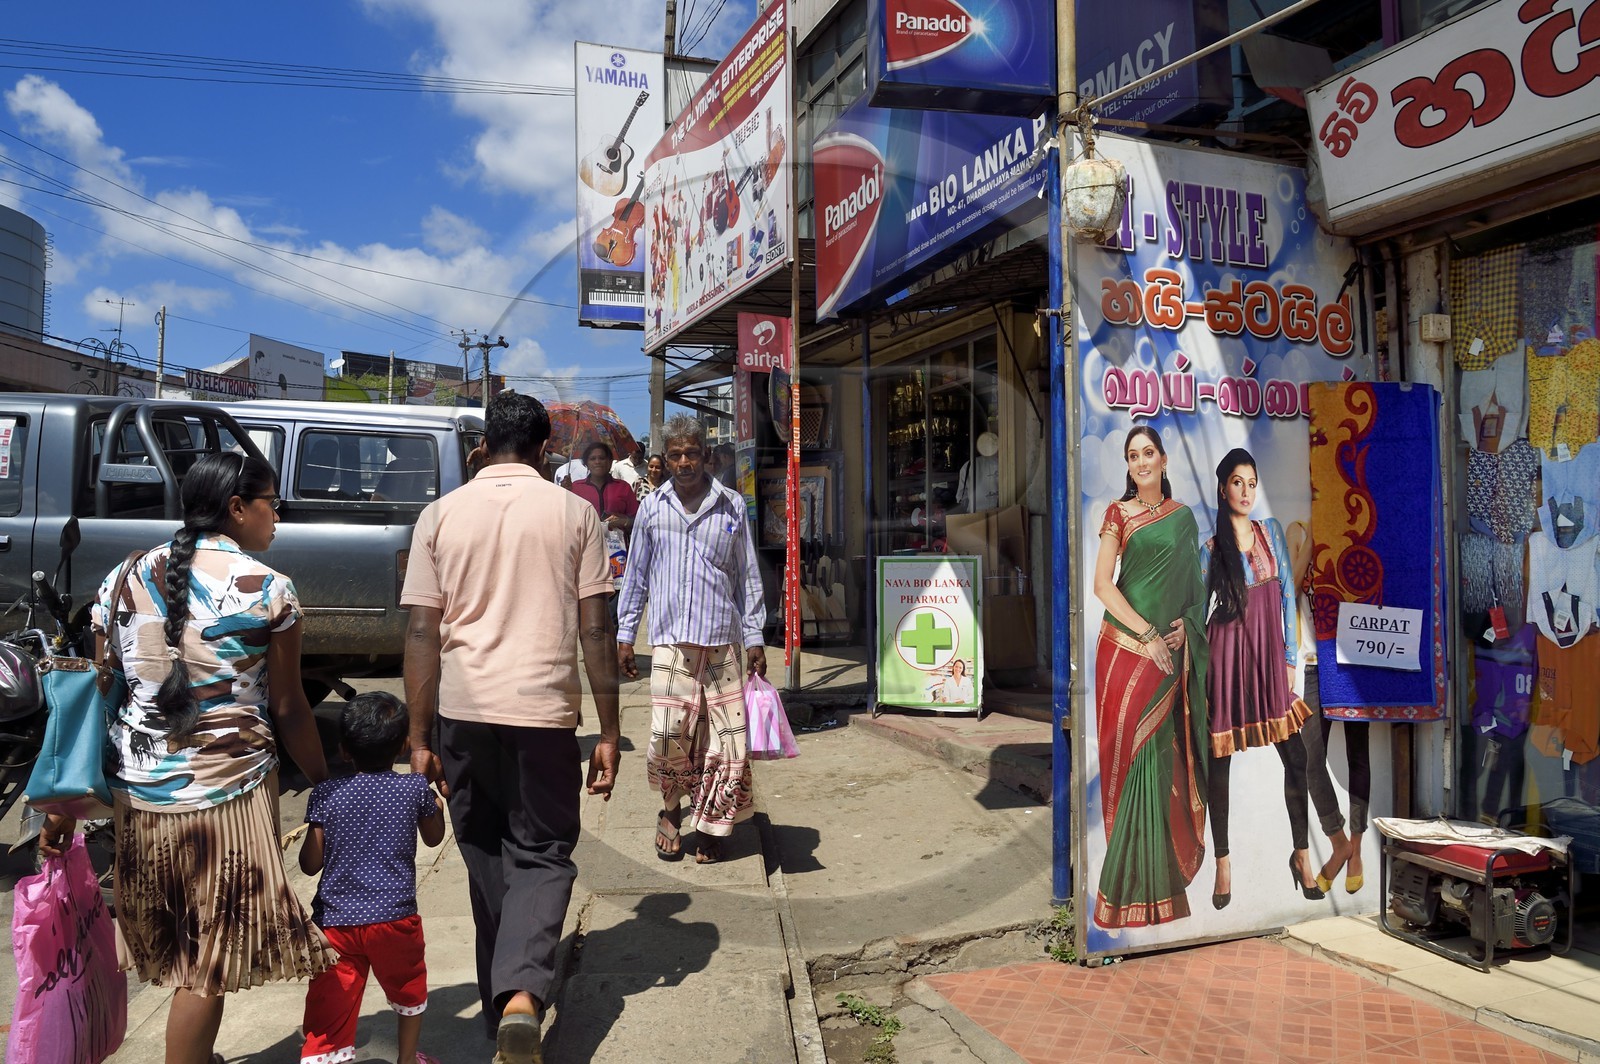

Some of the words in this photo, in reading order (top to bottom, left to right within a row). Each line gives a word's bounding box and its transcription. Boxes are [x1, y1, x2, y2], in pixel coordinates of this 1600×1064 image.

[896, 12, 966, 32] Panadol
[586, 66, 648, 89] YAMAHA
[686, 79, 719, 132] OLYMPIC
[721, 3, 784, 91] ENTERPRISE
[1104, 101, 1121, 117] TEL:
[735, 112, 759, 149] MUSIC
[962, 209, 981, 226] excessive
[982, 199, 998, 214] dosage
[998, 190, 1010, 203] could
[1018, 173, 1036, 192] harmful
[1142, 103, 1156, 119] your
[905, 202, 928, 224] NAVA
[929, 174, 957, 216] BIO
[962, 127, 1028, 194] LANKA
[825, 163, 879, 237] Panadol
[1166, 180, 1267, 267] STYLE
[766, 244, 785, 263] SONY
[744, 349, 785, 369] airtel
[885, 579, 910, 588] NAVA
[913, 579, 932, 588] BIO
[934, 579, 971, 588] LANKA
[900, 595, 959, 604] PHARMACY
[1350, 615, 1410, 632] CARPAT
[1356, 640, 1405, 659] 790/=
